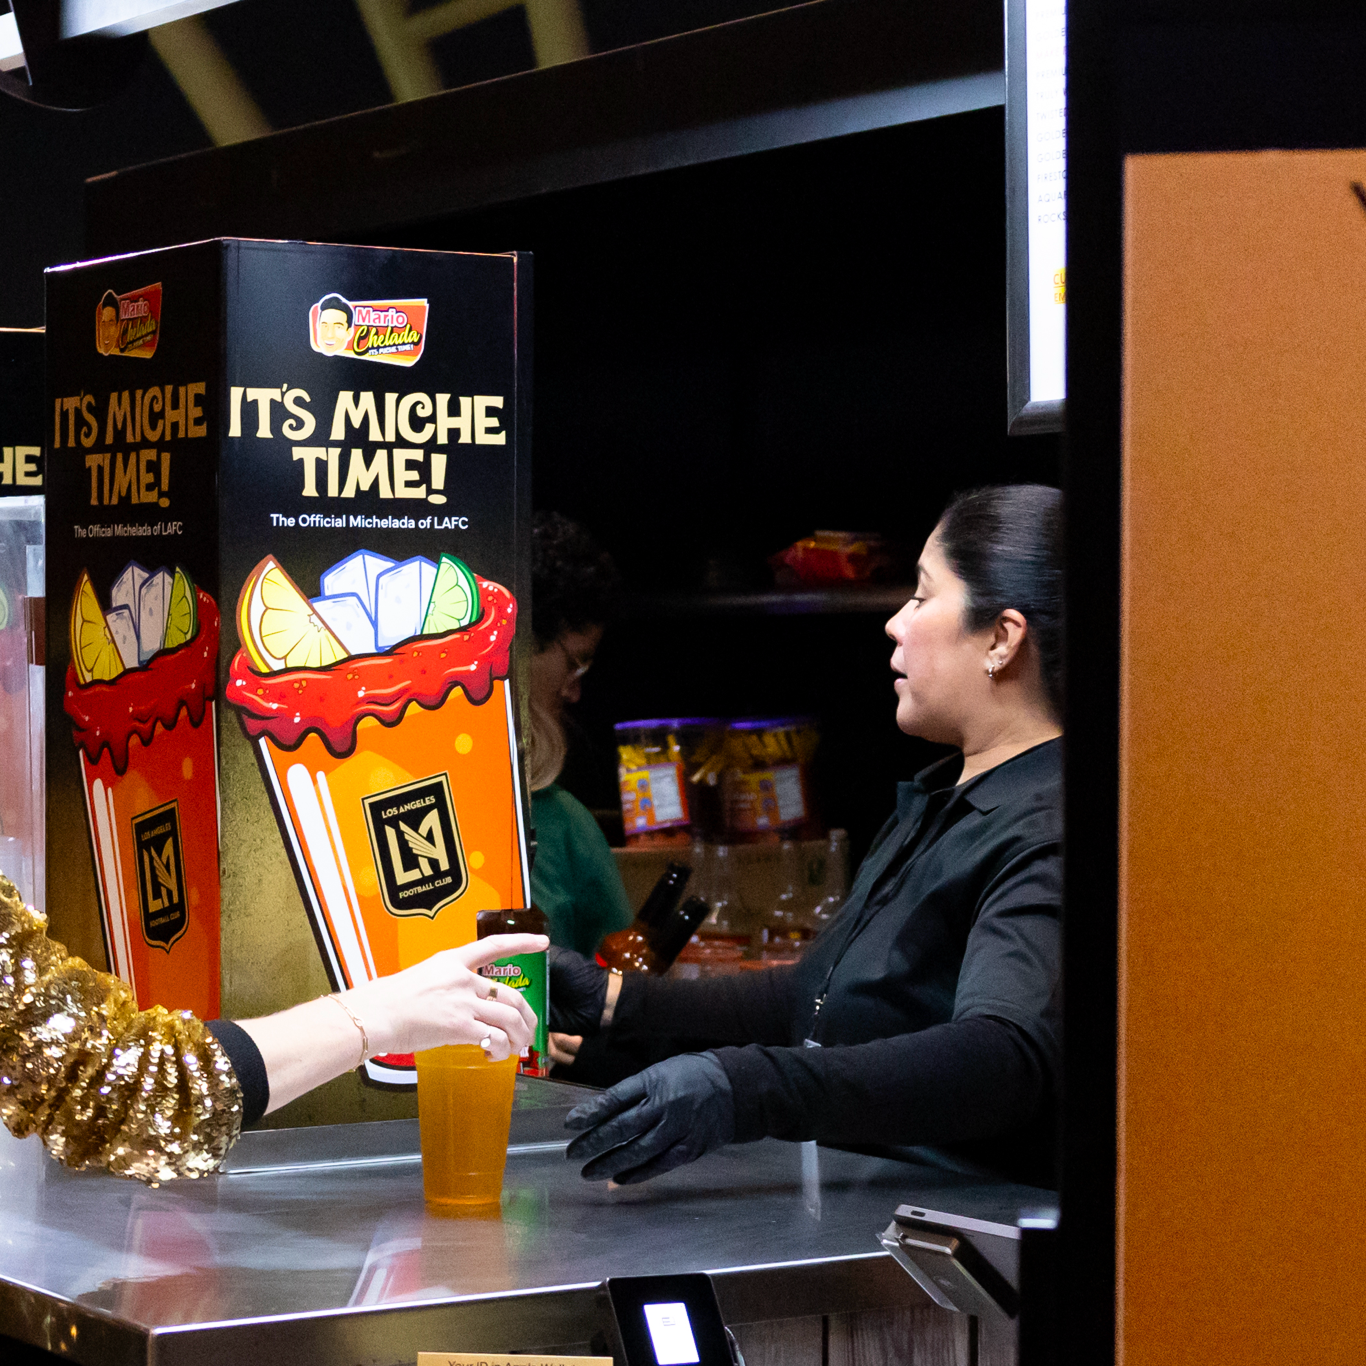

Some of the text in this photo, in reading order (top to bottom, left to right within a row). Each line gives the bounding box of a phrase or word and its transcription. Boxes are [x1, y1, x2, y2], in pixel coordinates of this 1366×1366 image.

[354, 306, 408, 328] Mario
[353, 324, 421, 353] Chelada
[53, 381, 208, 449] IT'S MICHE
[228, 382, 506, 446] IT'S MICHE
[85, 447, 171, 508] TIME!
[291, 446, 448, 505] TIME!
[73, 521, 183, 538] The Official Michelada of LAFC
[270, 513, 469, 530] The Official Michelada of LAFC
[381, 795, 436, 819] LOS ANGELES
[398, 876, 453, 899] FOOTBALL CLUB
[482, 964, 522, 978] Mario
